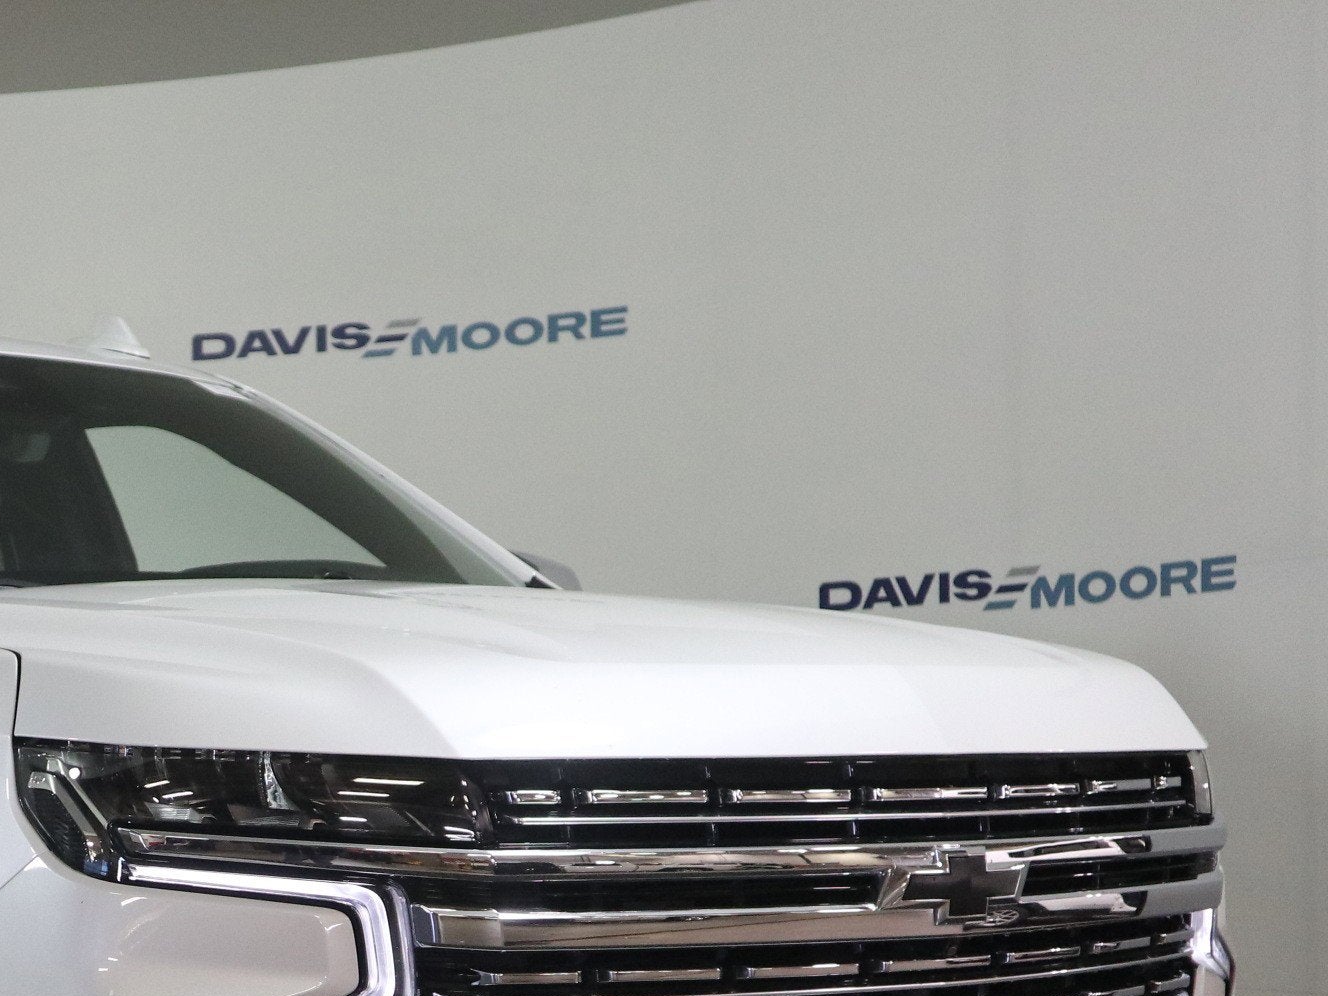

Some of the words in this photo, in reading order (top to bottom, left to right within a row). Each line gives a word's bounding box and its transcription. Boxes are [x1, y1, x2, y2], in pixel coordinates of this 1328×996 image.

[191, 322, 370, 361] DAVIS
[410, 305, 628, 358] MOORE
[819, 569, 992, 611] DAVIS
[1030, 554, 1237, 610] MOORE
